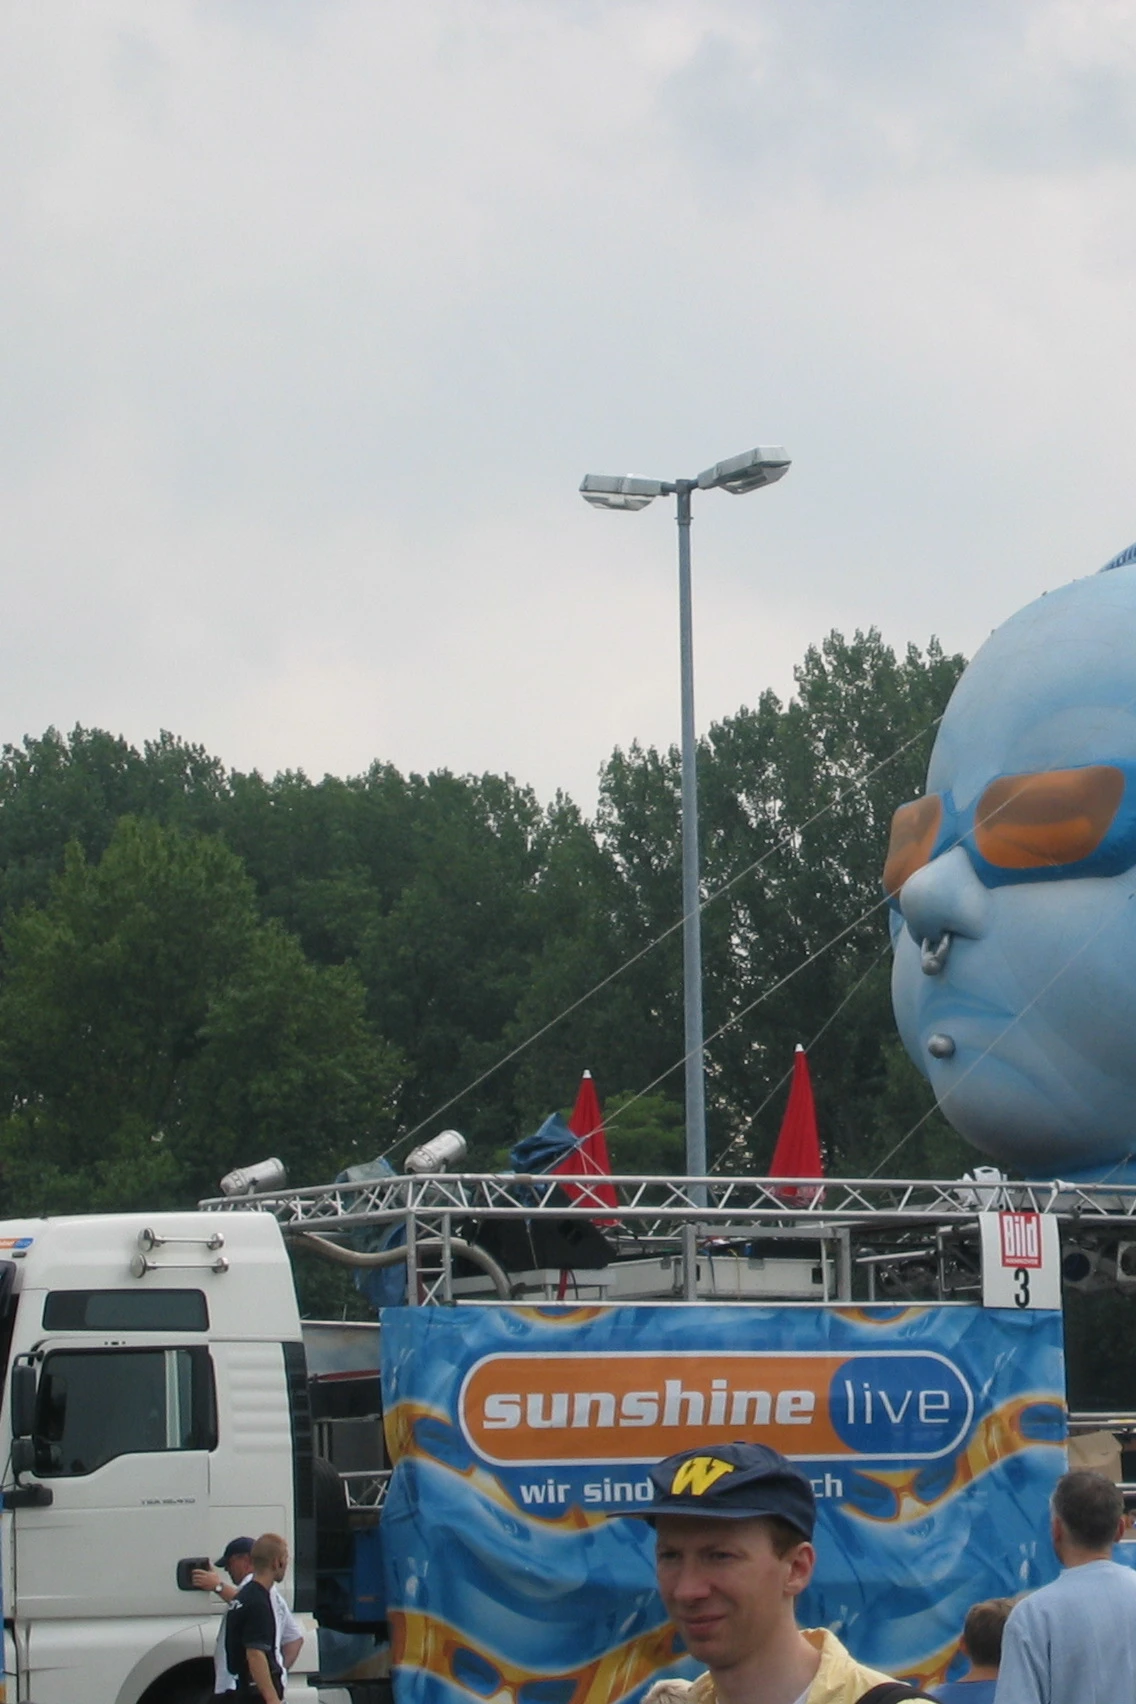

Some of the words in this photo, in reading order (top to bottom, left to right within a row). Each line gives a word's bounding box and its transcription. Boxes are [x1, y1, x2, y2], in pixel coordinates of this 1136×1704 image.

[1014, 1267, 1030, 1308] 3
[483, 1379, 816, 1429] sunshine
[845, 1380, 950, 1425] live
[520, 1479, 571, 1504] wir
[584, 1477, 653, 1502] sind
[671, 1456, 735, 1496] W
